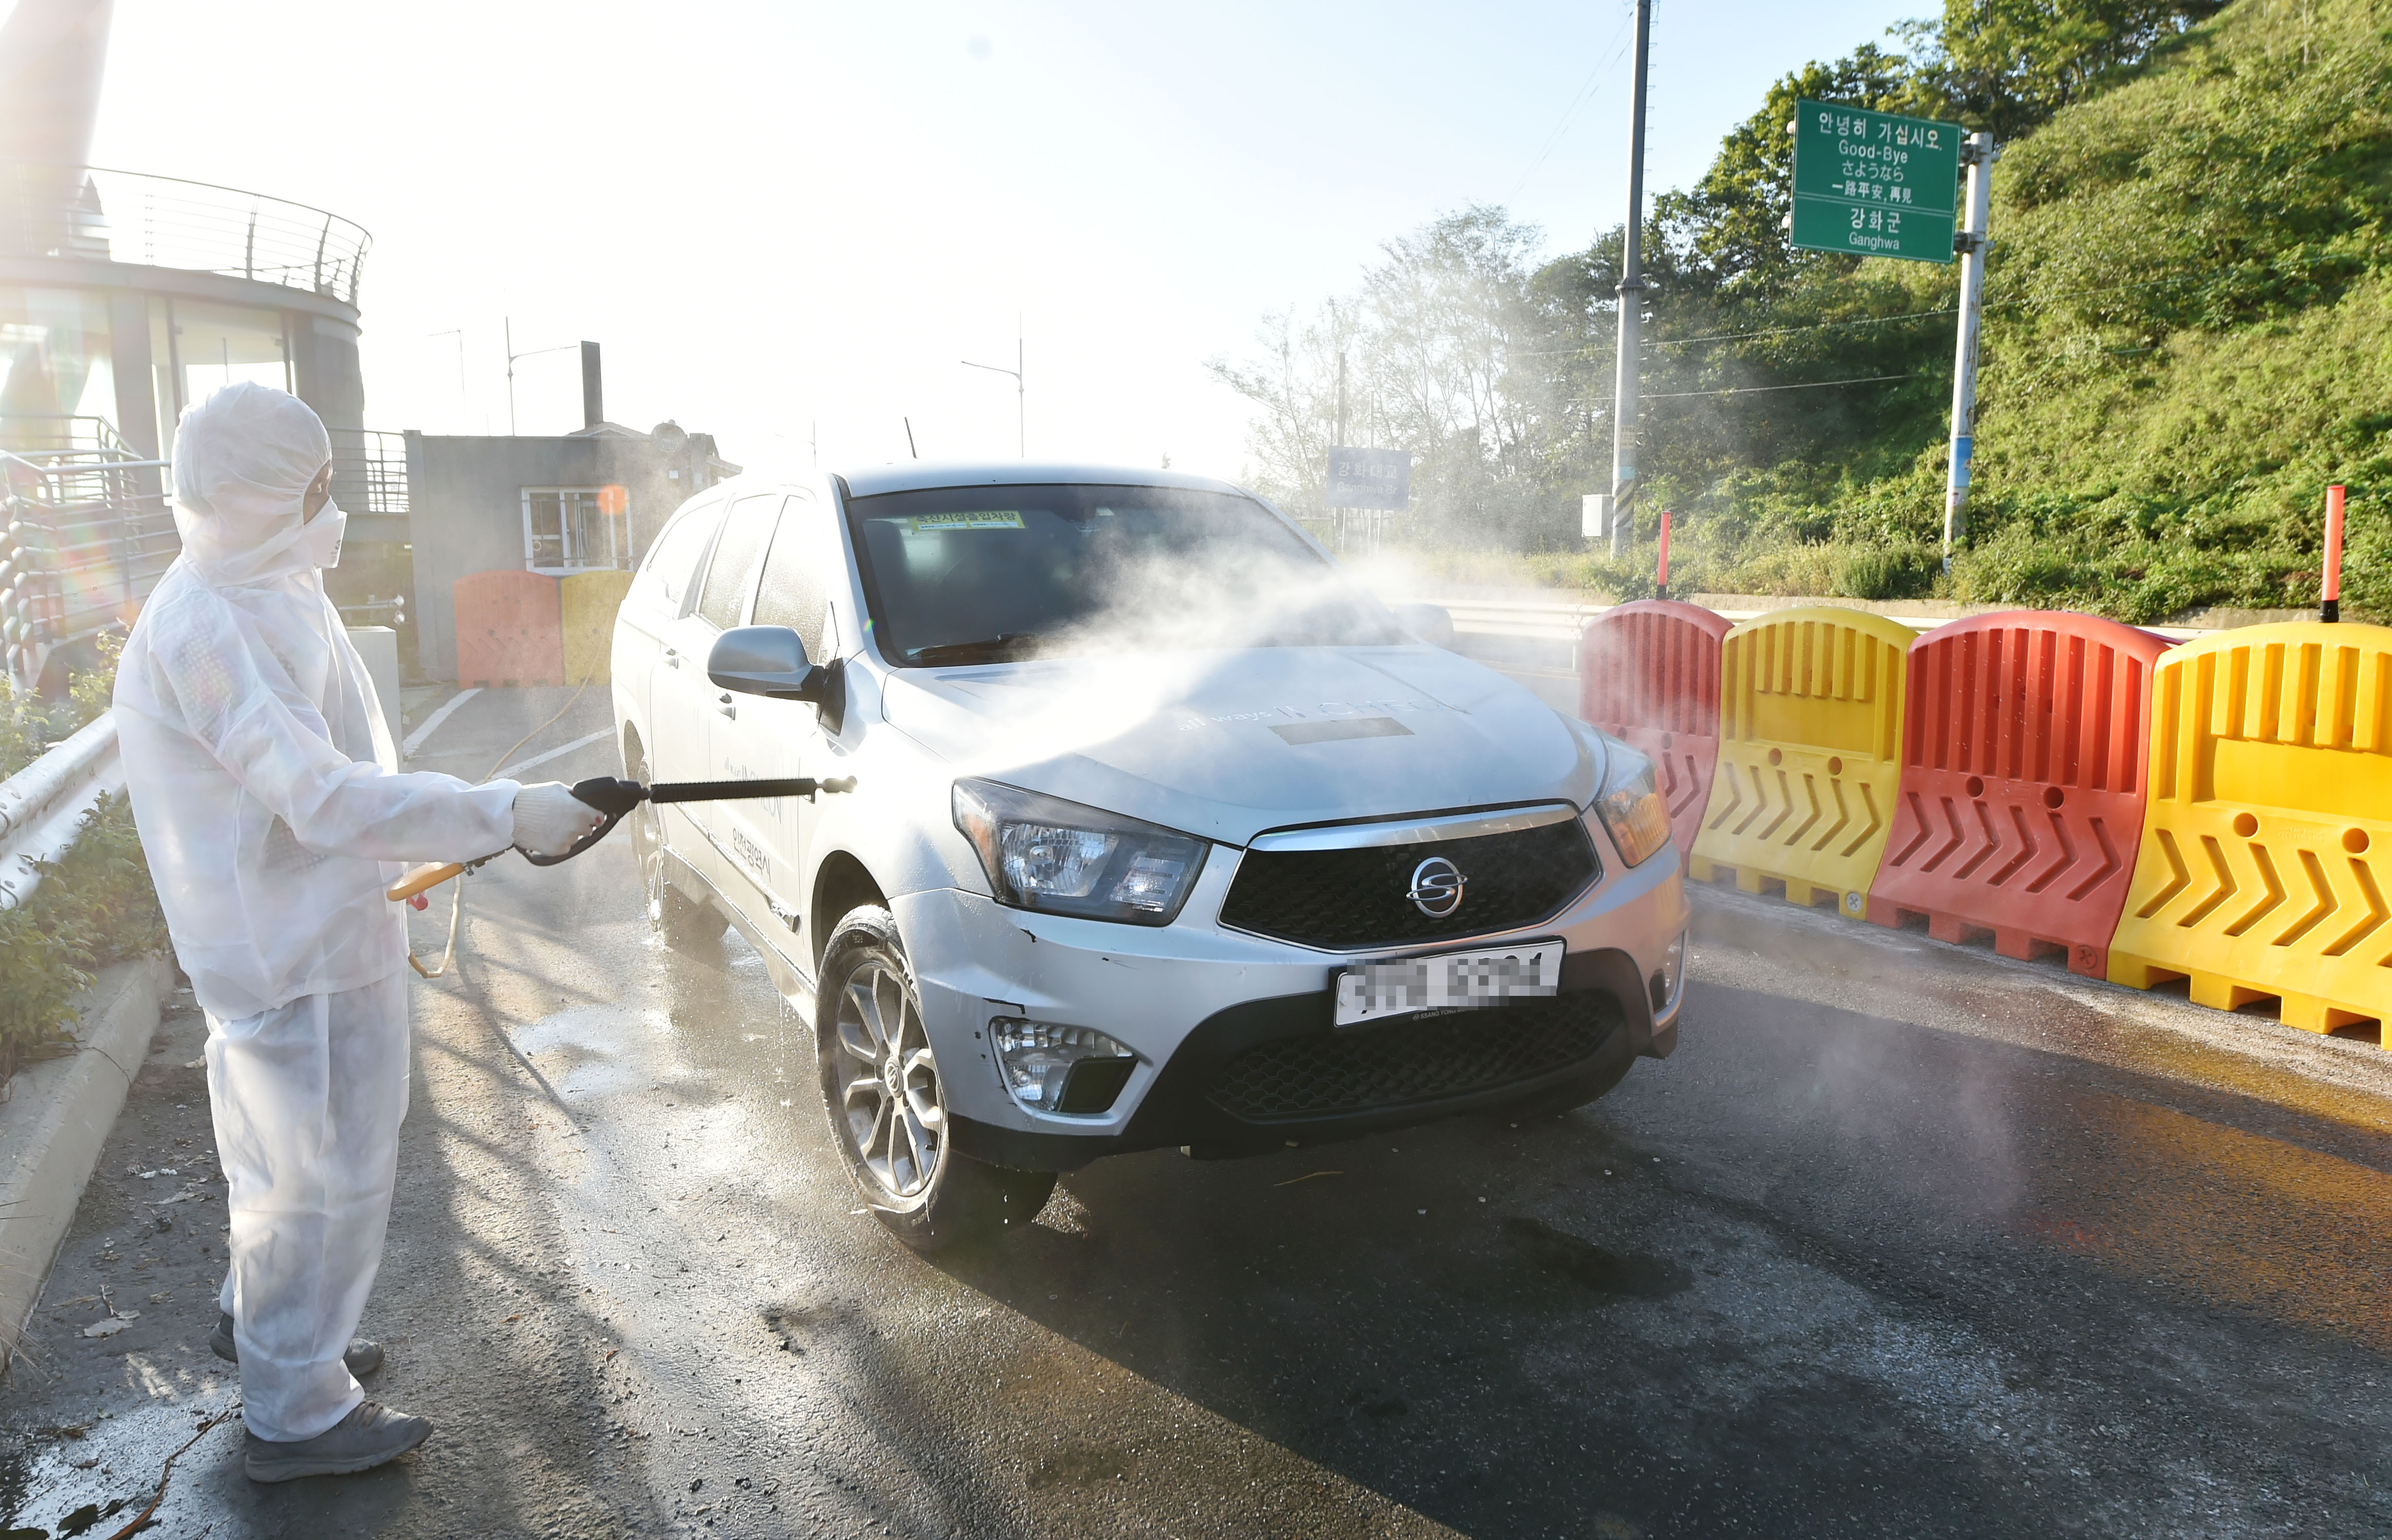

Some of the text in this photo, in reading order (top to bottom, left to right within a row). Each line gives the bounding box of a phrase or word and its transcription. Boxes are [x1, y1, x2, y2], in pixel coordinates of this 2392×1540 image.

[1819, 112, 1866, 139] 안녕히
[1839, 140, 1908, 164] Good-Bye
[1842, 160, 1904, 182] さようなら
[1850, 208, 1901, 234] 강화군
[1849, 232, 1900, 250] Ganghwa
[1338, 461, 1397, 478] 강화대교
[1337, 481, 1383, 493] Ganghwa
[1178, 718, 1207, 732] all
[1211, 710, 1272, 723] ways
[733, 827, 771, 882] 인천광역시
